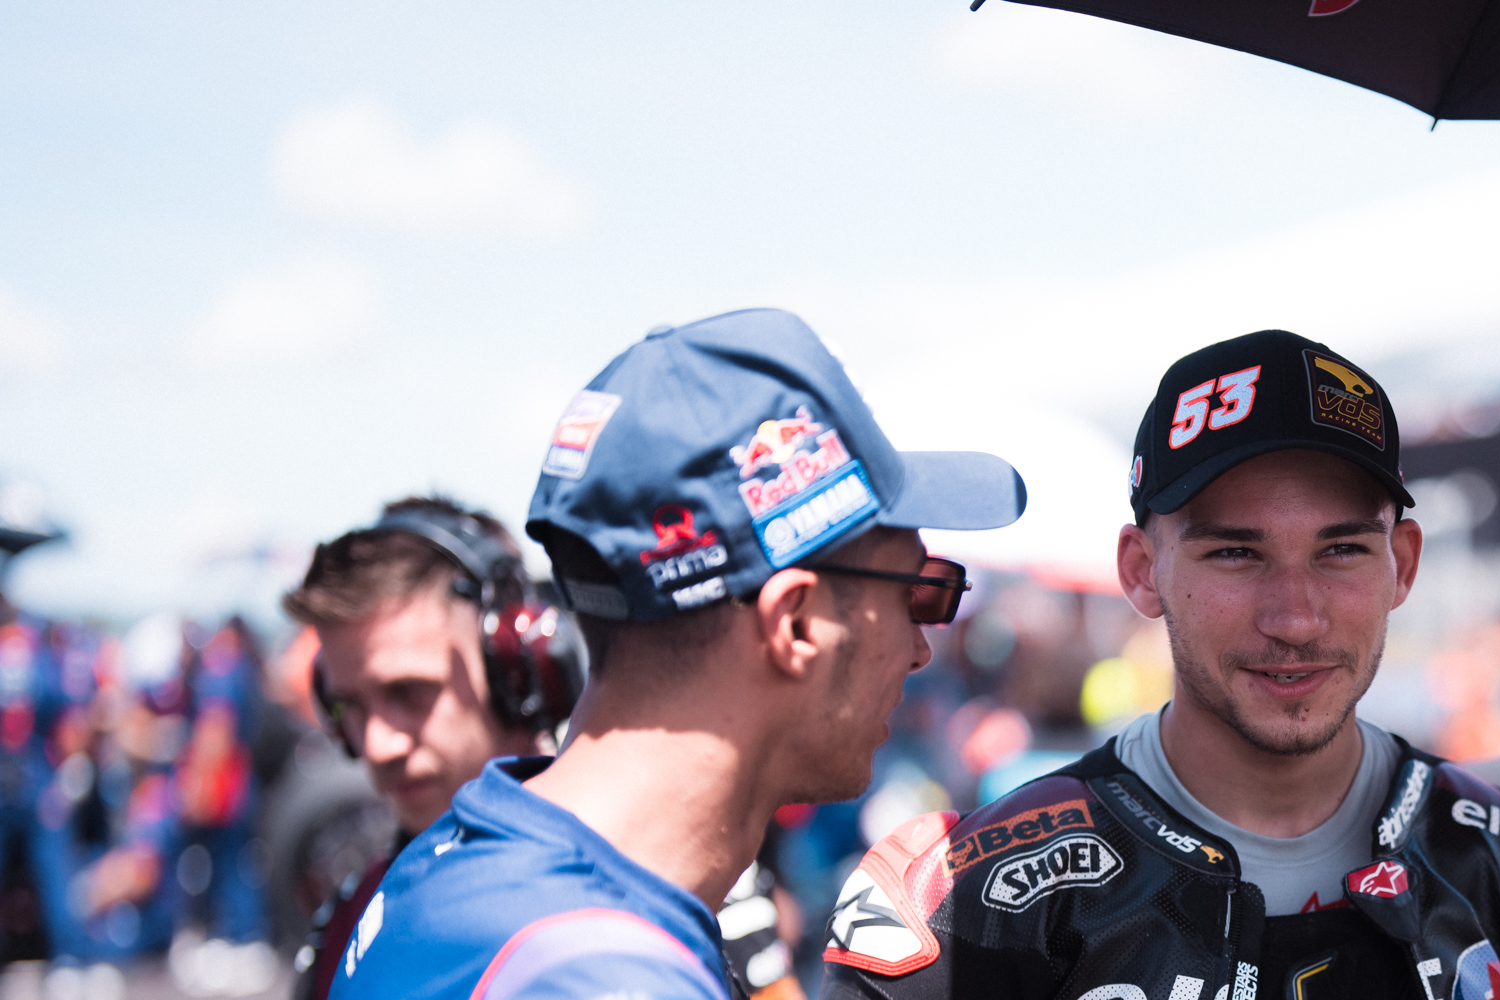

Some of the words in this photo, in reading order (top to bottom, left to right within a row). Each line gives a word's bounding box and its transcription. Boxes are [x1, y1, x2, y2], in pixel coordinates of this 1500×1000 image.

[1168, 364, 1262, 450] 53
[1321, 412, 1356, 427] RACING
[1361, 426, 1382, 440] TEAM
[977, 808, 1088, 854] Beta
[1001, 842, 1100, 902] SHOEI
